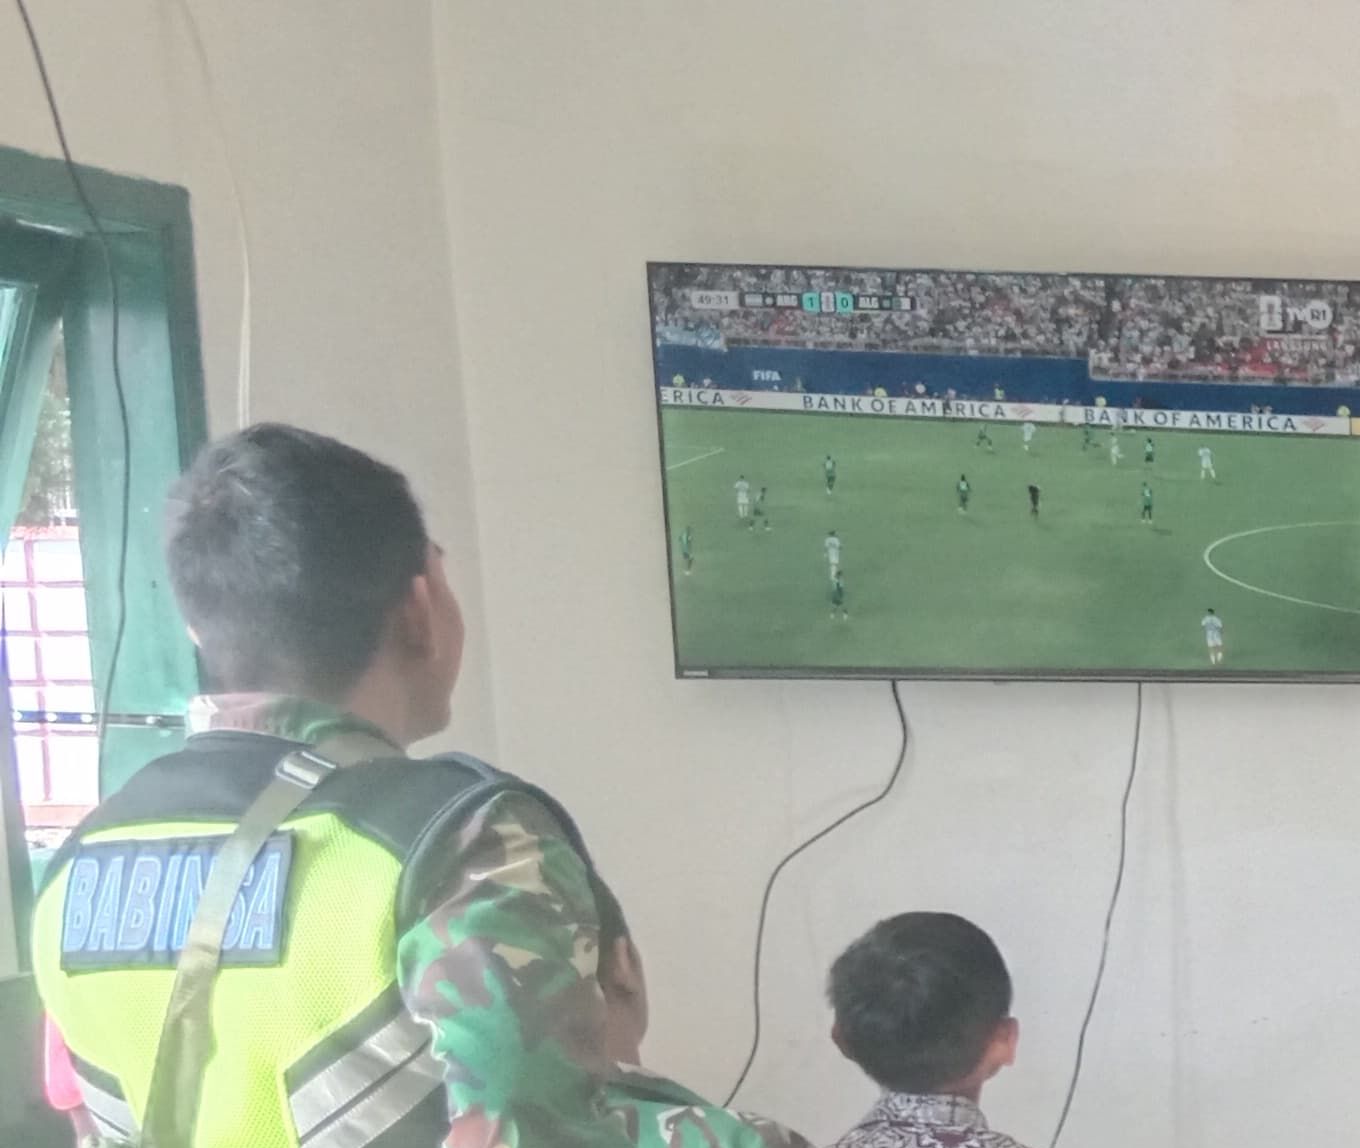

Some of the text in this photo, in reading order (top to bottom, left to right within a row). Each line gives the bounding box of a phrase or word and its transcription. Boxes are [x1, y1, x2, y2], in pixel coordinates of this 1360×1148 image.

[753, 370, 782, 381] FIFA
[803, 395, 1006, 418] BANK OF AMERICA
[1085, 408, 1297, 432] BANK OF AMERICA
